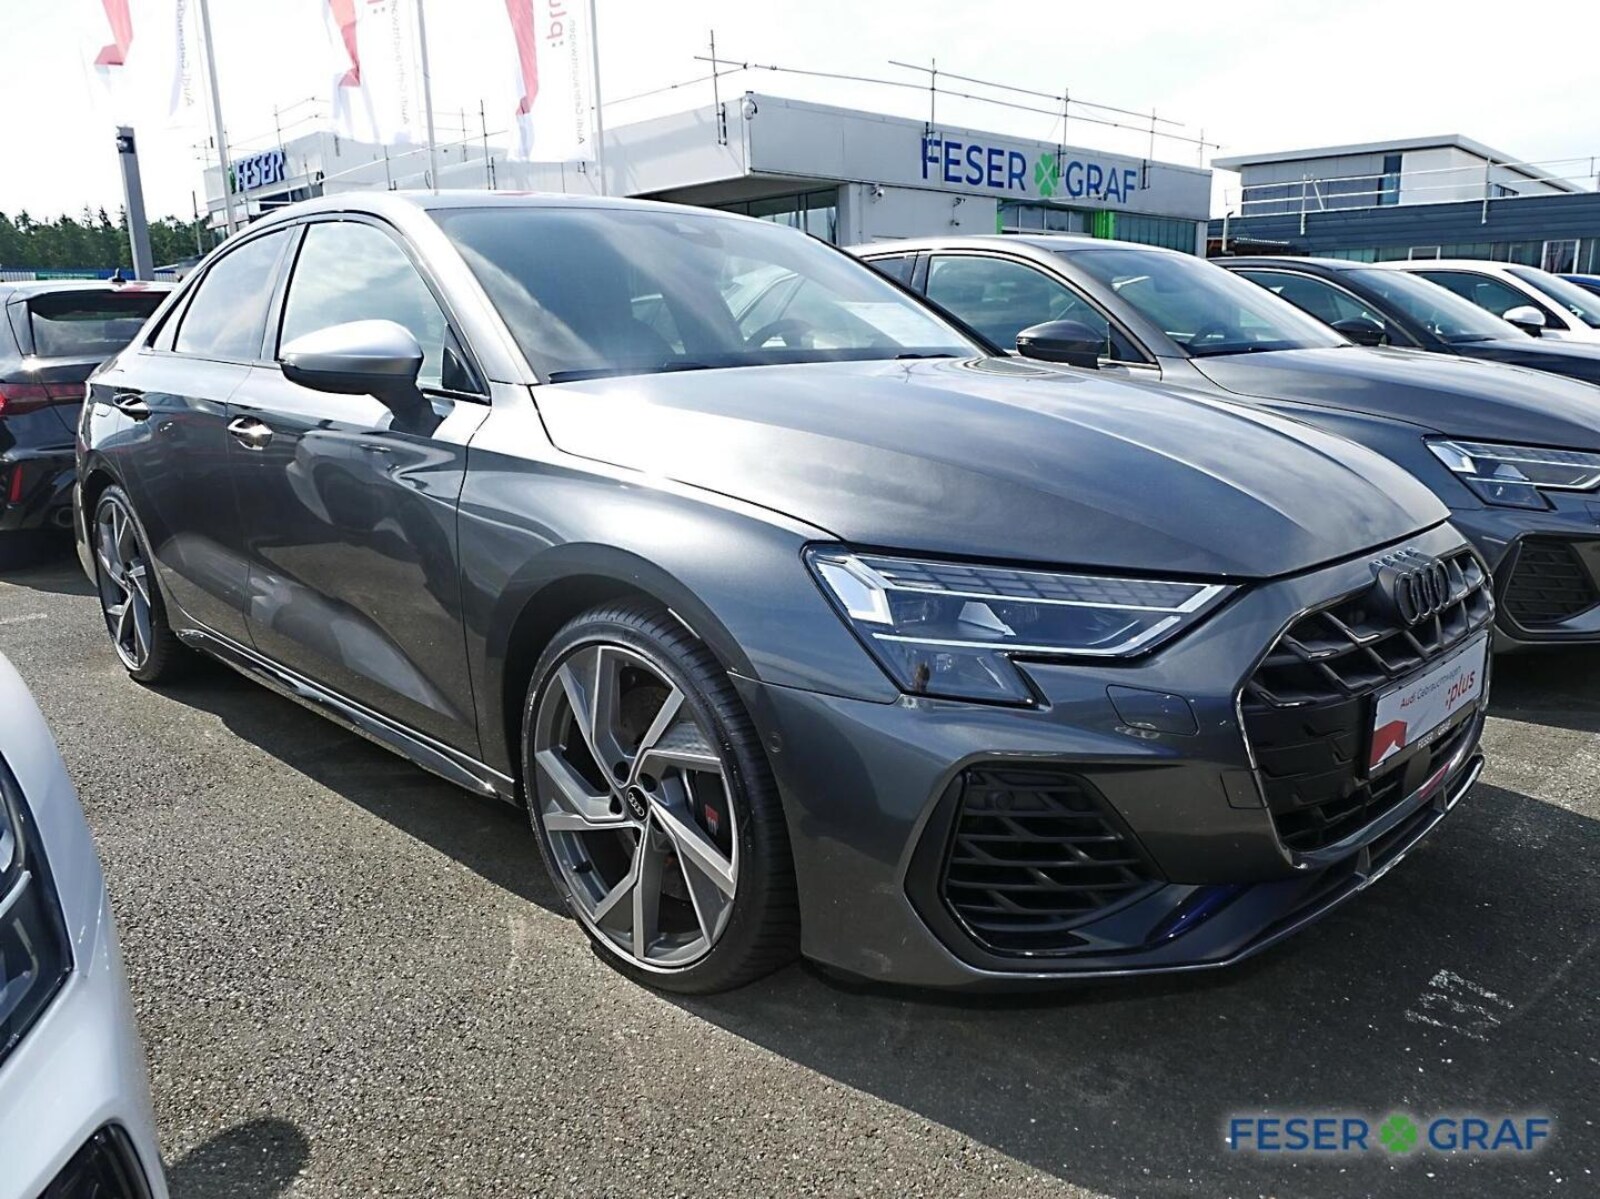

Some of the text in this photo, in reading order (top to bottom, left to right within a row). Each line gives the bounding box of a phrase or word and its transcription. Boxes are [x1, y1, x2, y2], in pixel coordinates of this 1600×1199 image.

[236, 149, 286, 193] FESER
[921, 136, 1138, 204] FESER GRAF
